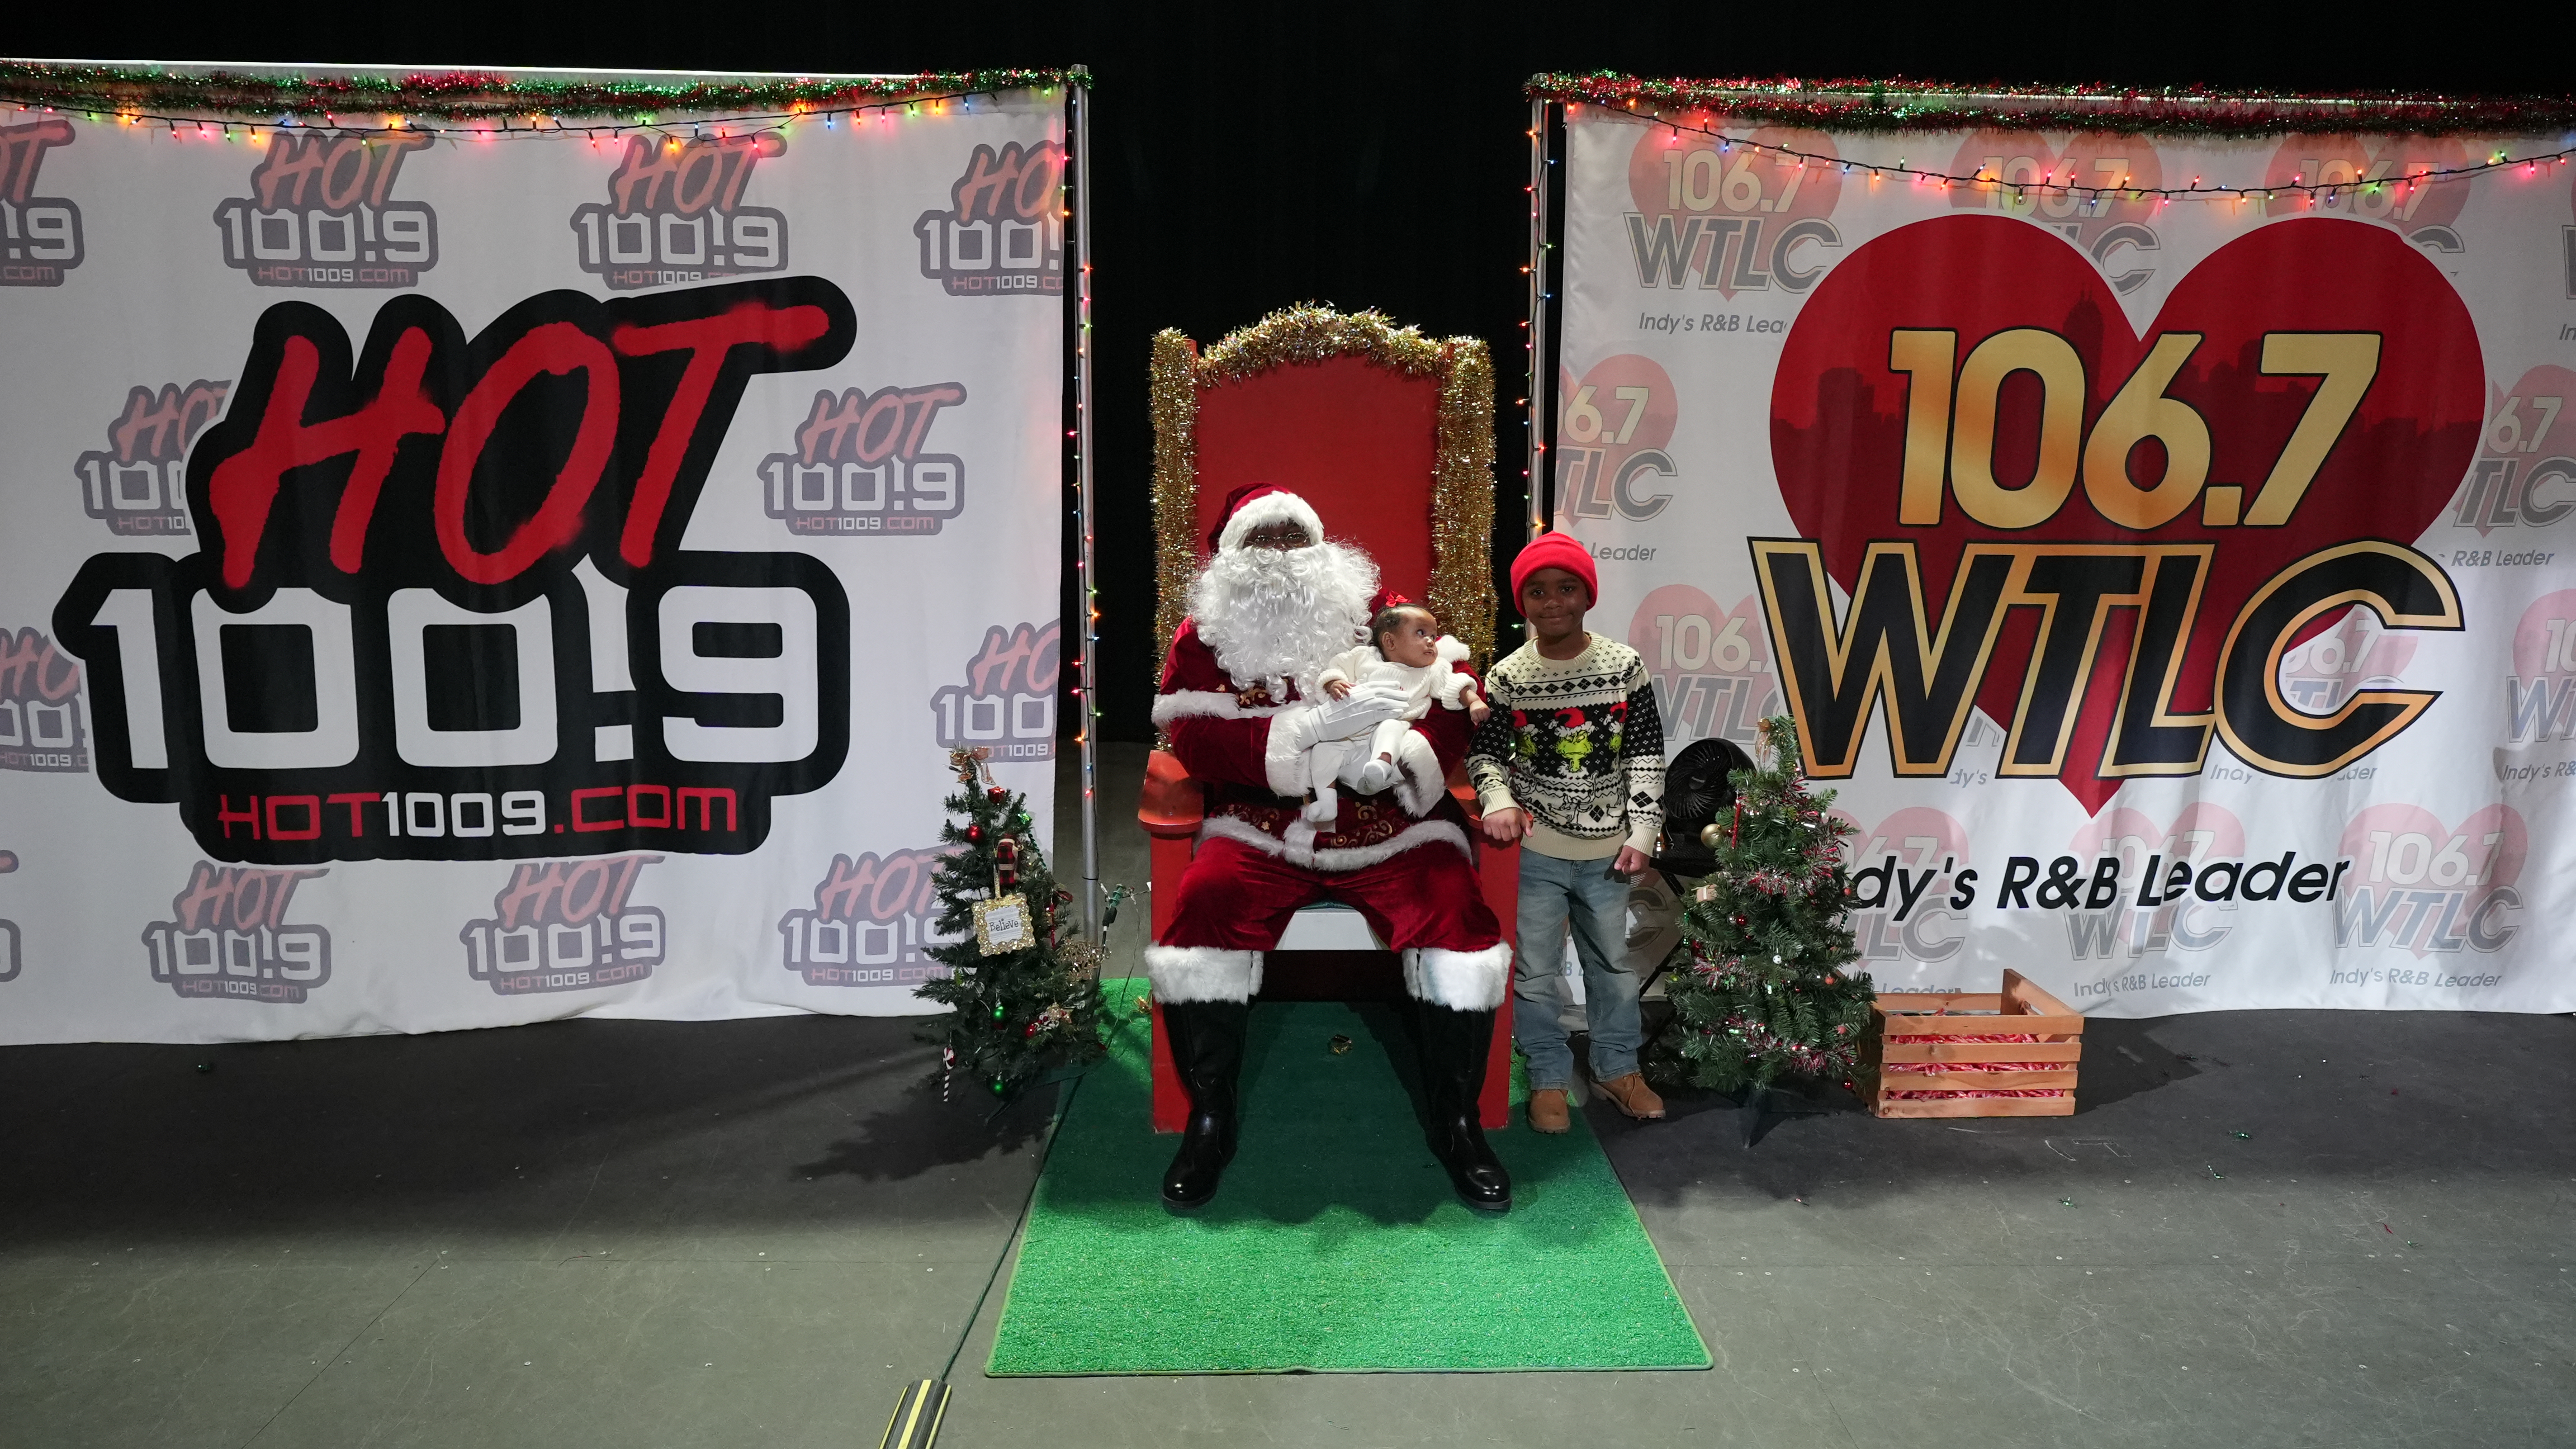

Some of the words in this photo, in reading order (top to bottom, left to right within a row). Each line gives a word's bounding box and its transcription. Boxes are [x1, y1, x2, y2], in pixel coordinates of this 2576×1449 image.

[259, 131, 427, 209] HOT
[615, 139, 780, 215] HOT
[959, 148, 1064, 221] HO
[1664, 149, 1810, 213] 106.7
[1983, 155, 2130, 219] 106.7
[2299, 159, 2440, 221] 106.7
[1623, 212, 1843, 293] WTLC
[1639, 312, 1694, 334] Indy's
[1700, 314, 1740, 332] R&B
[1746, 315, 1787, 334] Lea
[116, 387, 228, 461] HO
[209, 302, 830, 588] HOT
[802, 389, 960, 463] HOT
[1890, 325, 2383, 531] 106.7
[795, 517, 934, 530] HOT1009.COM
[1590, 542, 1657, 561] Leader
[2451, 550, 2492, 567] R&B
[2496, 549, 2555, 566] Leader
[1747, 536, 2465, 780] WTLC
[2503, 763, 2551, 783] Indy's
[218, 784, 737, 841] HOT1009.COM
[1996, 855, 2120, 910] R&B
[2137, 850, 2350, 907] Leader
[2369, 830, 2505, 887] 106.7
[181, 868, 321, 930] HOT
[503, 855, 660, 929] HOT
[2332, 886, 2523, 954] WTLC
[989, 918, 1019, 931] Believe
[2122, 974, 2146, 992] R&B
[2152, 972, 2211, 989] Leader
[2329, 967, 2383, 987] Indy's
[2389, 968, 2430, 986] R&B
[2434, 973, 2502, 988] Leader
